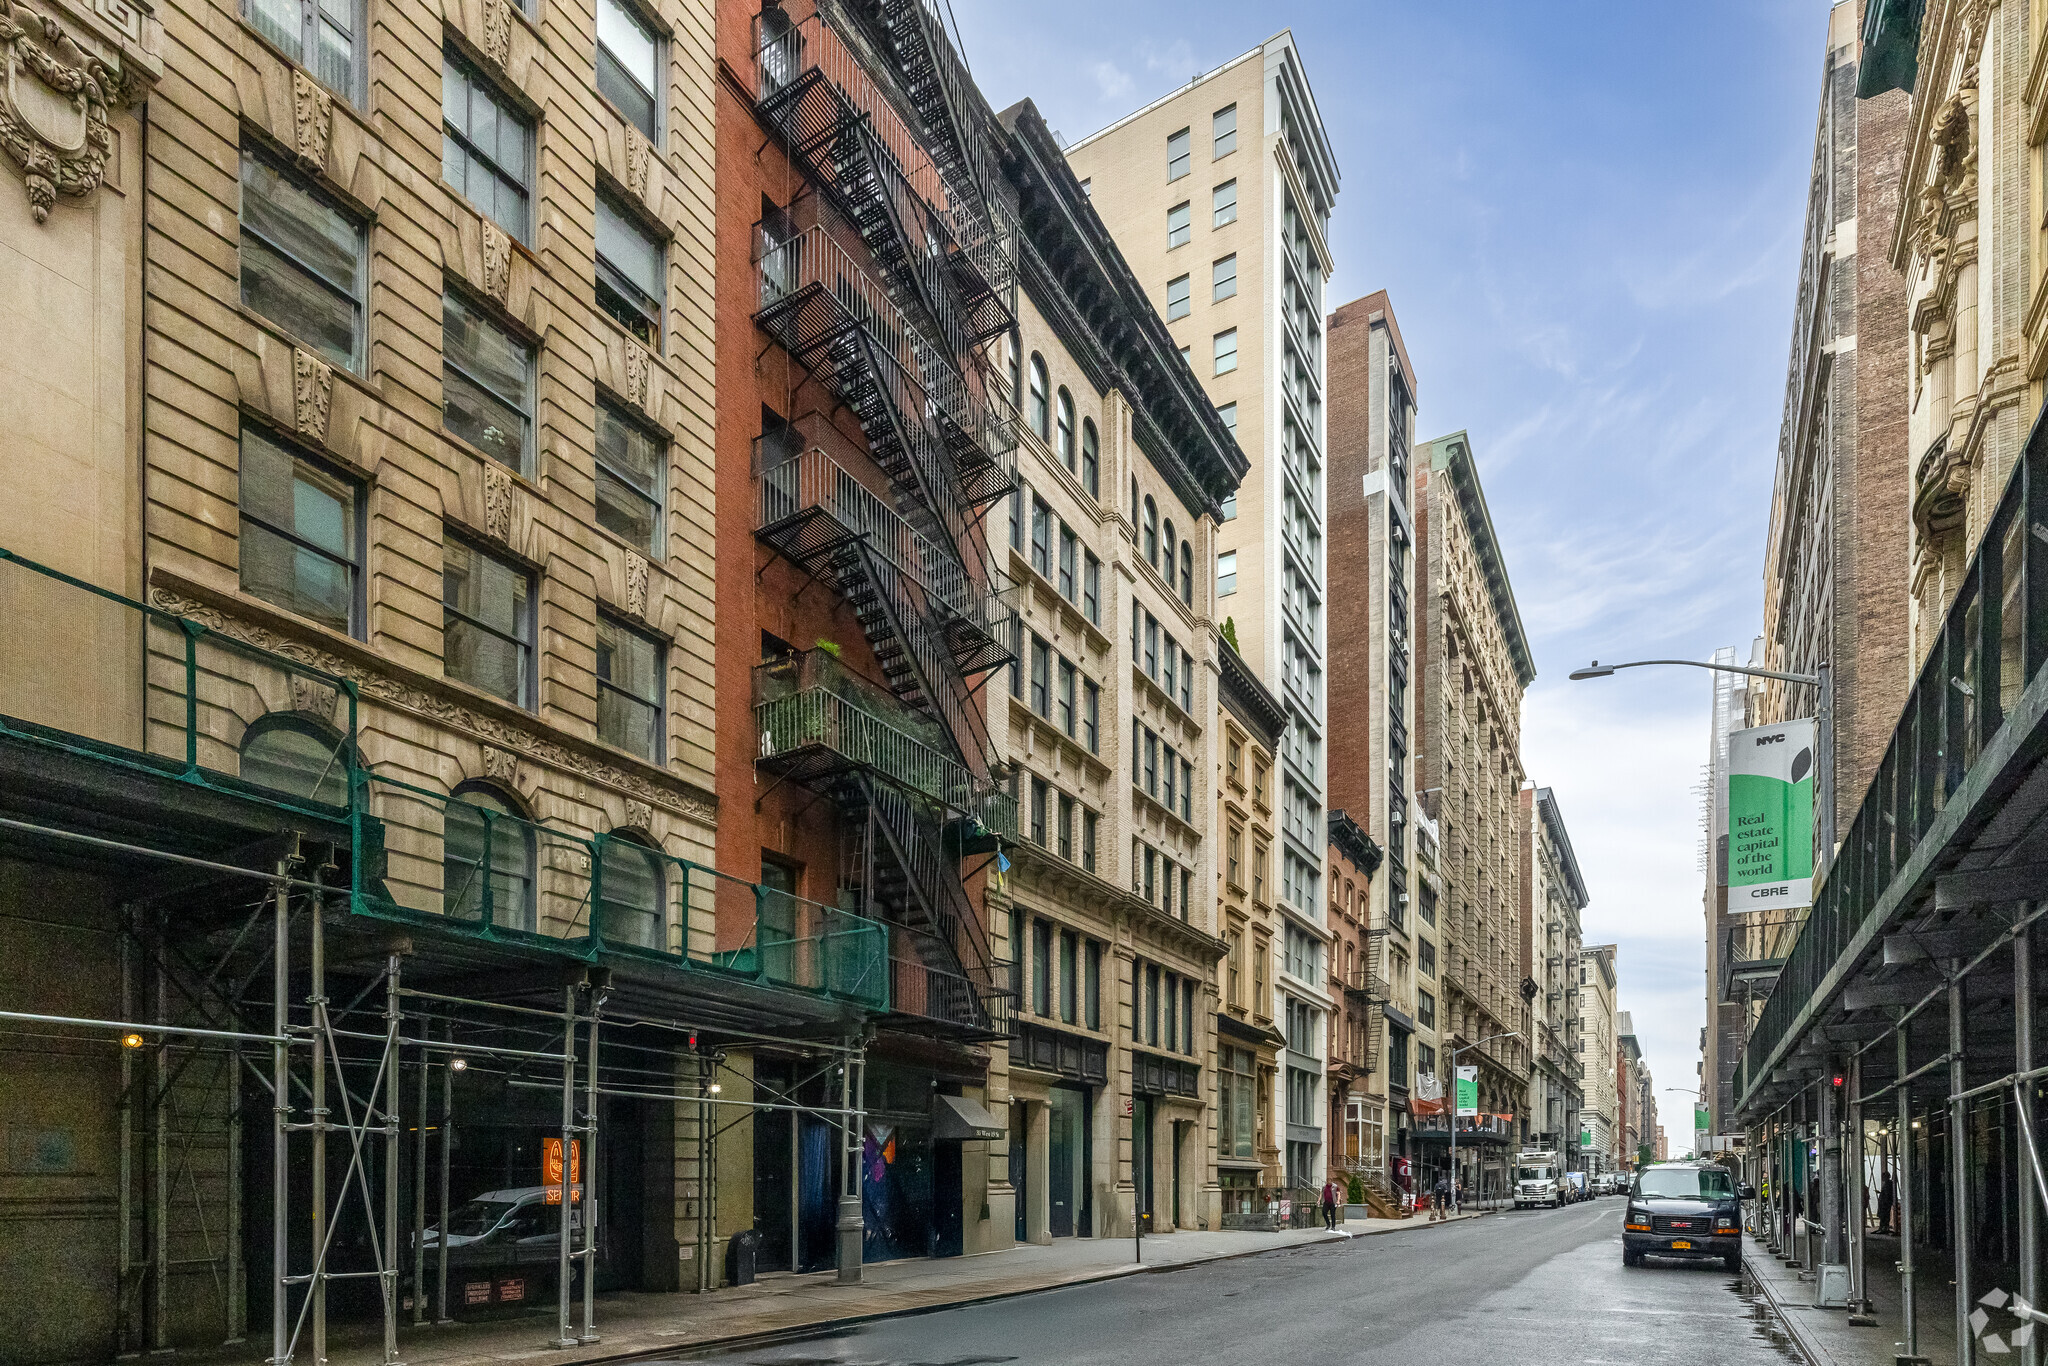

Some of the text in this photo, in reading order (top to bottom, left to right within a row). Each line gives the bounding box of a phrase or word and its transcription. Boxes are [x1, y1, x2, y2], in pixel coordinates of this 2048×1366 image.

[1756, 733, 1785, 746] NYC
[1738, 813, 1765, 826] Real
[1737, 827, 1773, 839] estate
[1737, 837, 1778, 853] capital
[1737, 852, 1772, 864] of the
[1738, 864, 1772, 877] world
[1751, 886, 1788, 898] CBRE
